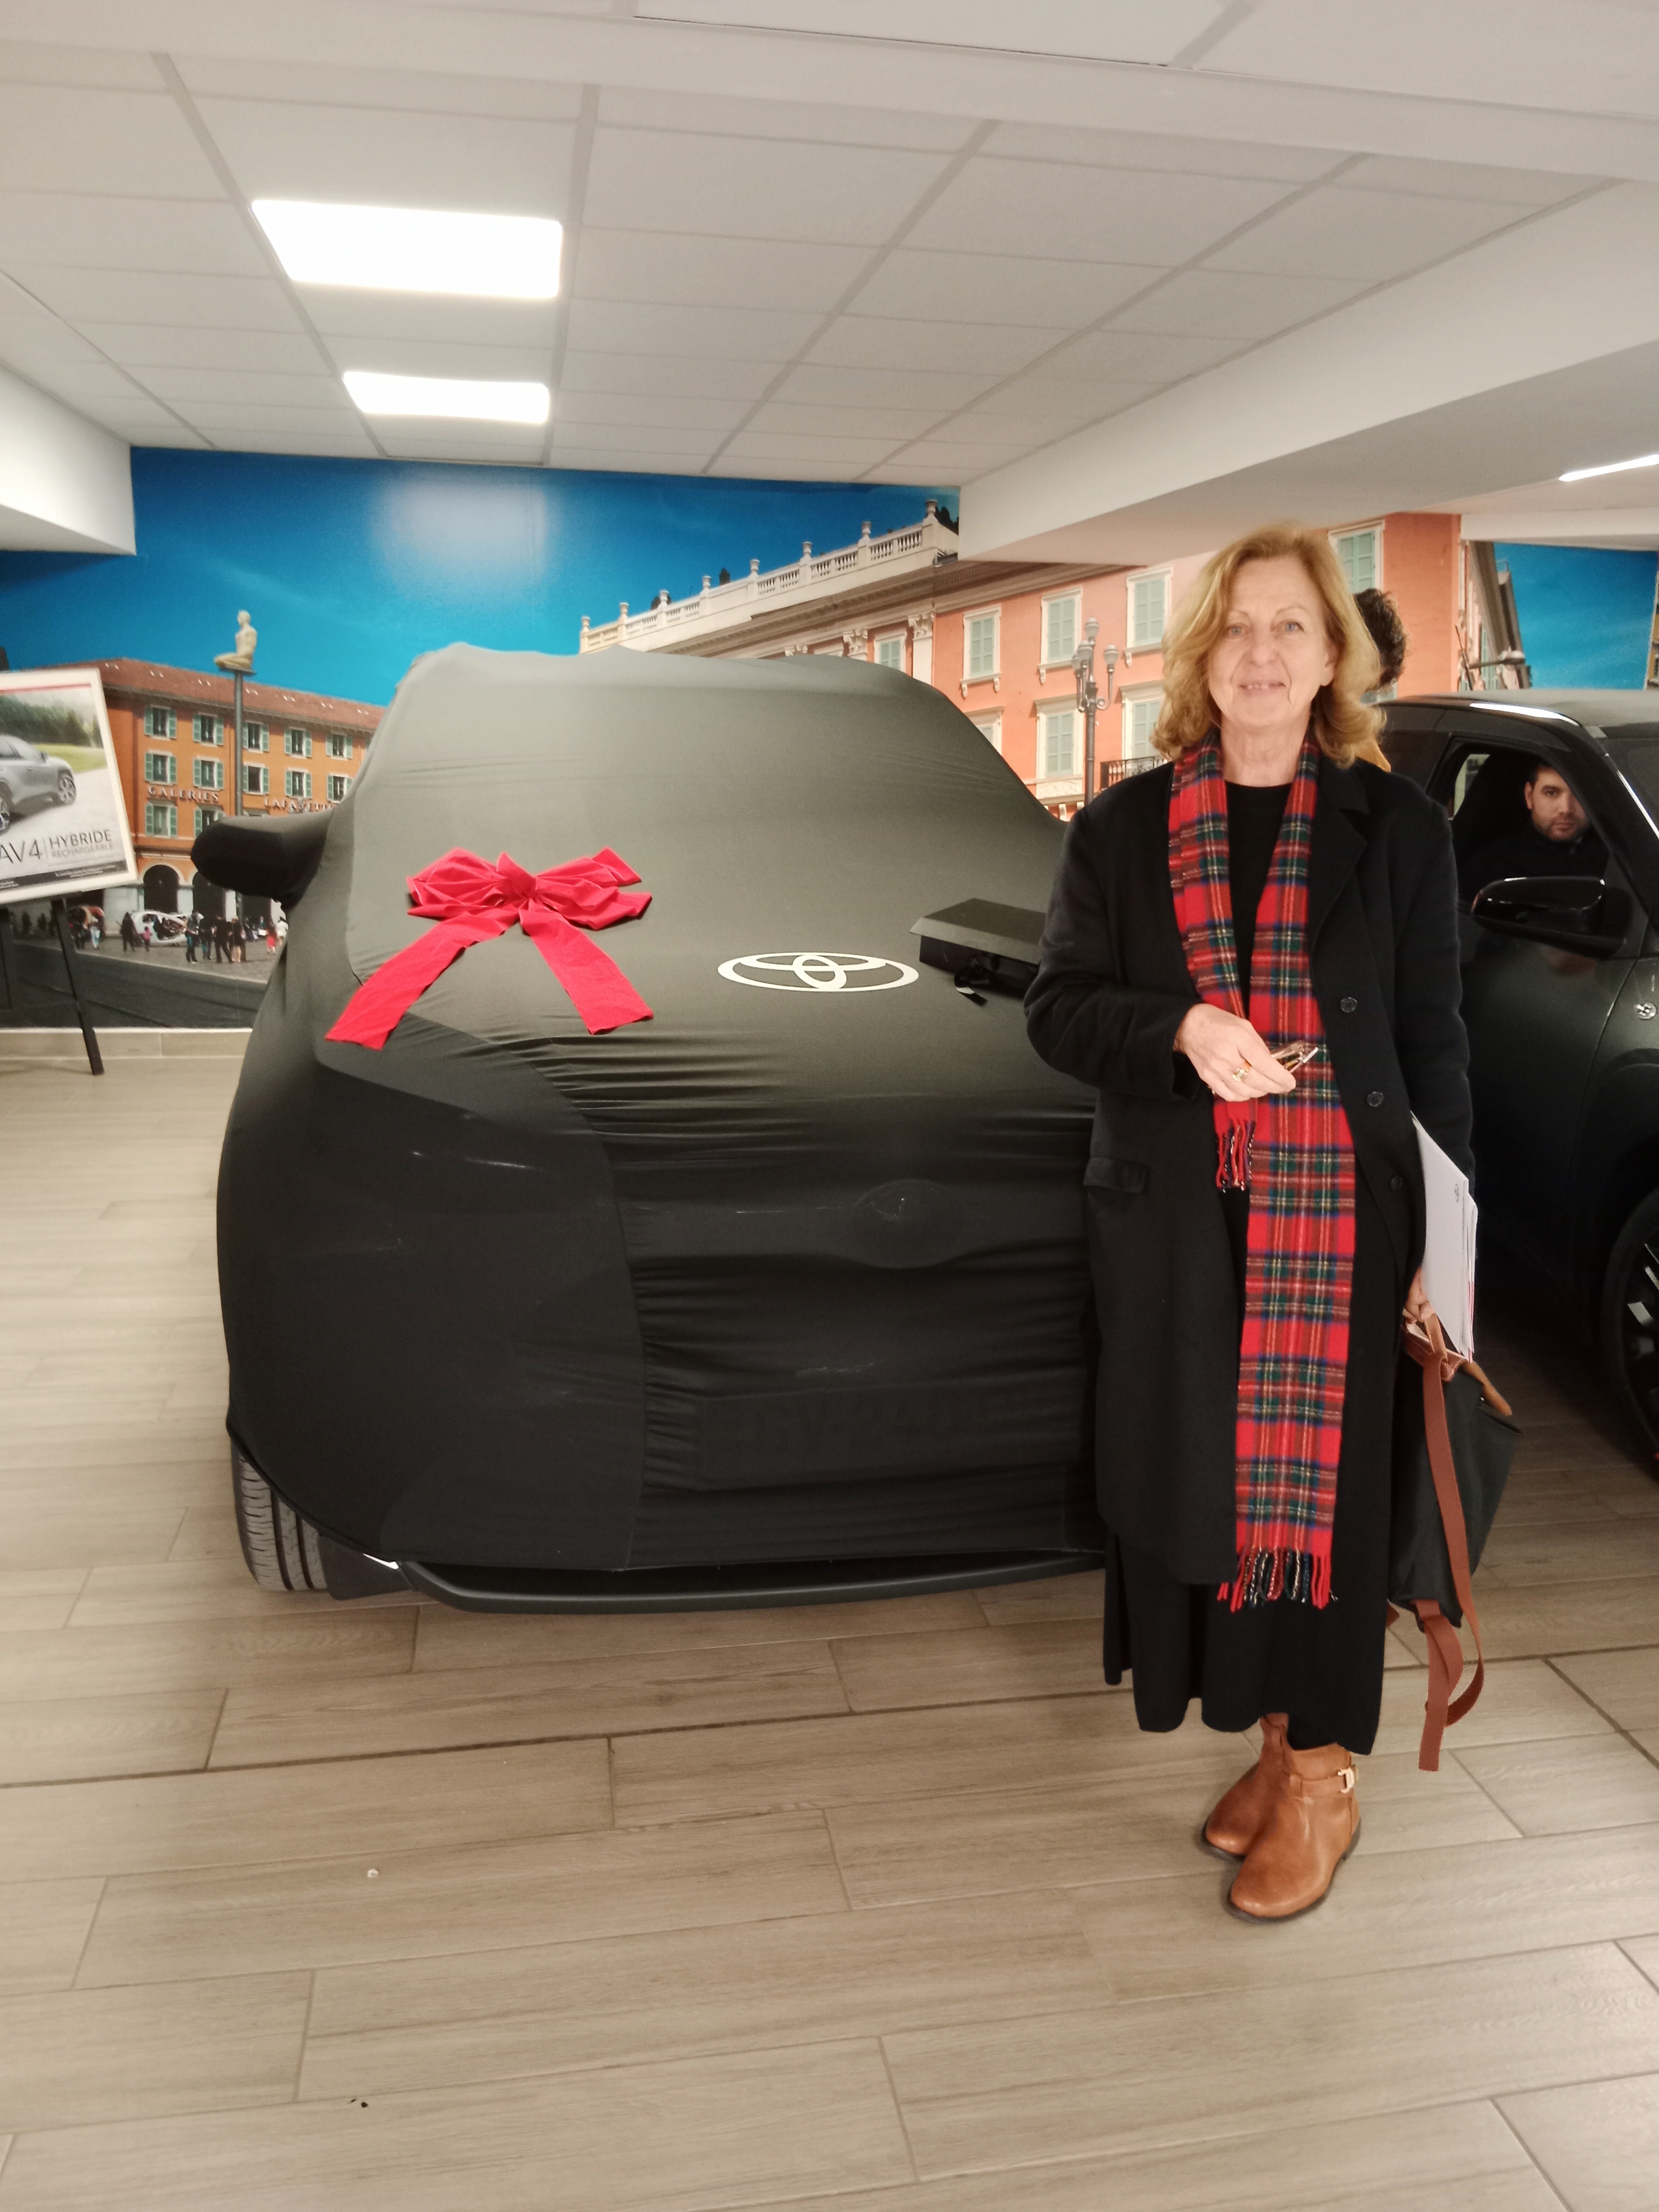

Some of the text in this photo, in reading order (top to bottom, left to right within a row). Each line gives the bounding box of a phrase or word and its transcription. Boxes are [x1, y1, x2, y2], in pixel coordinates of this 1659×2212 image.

[148, 786, 218, 802] GALERIES
[49, 829, 112, 849] HYBRIDE
[52, 843, 113, 858] RECHARGEABLE
